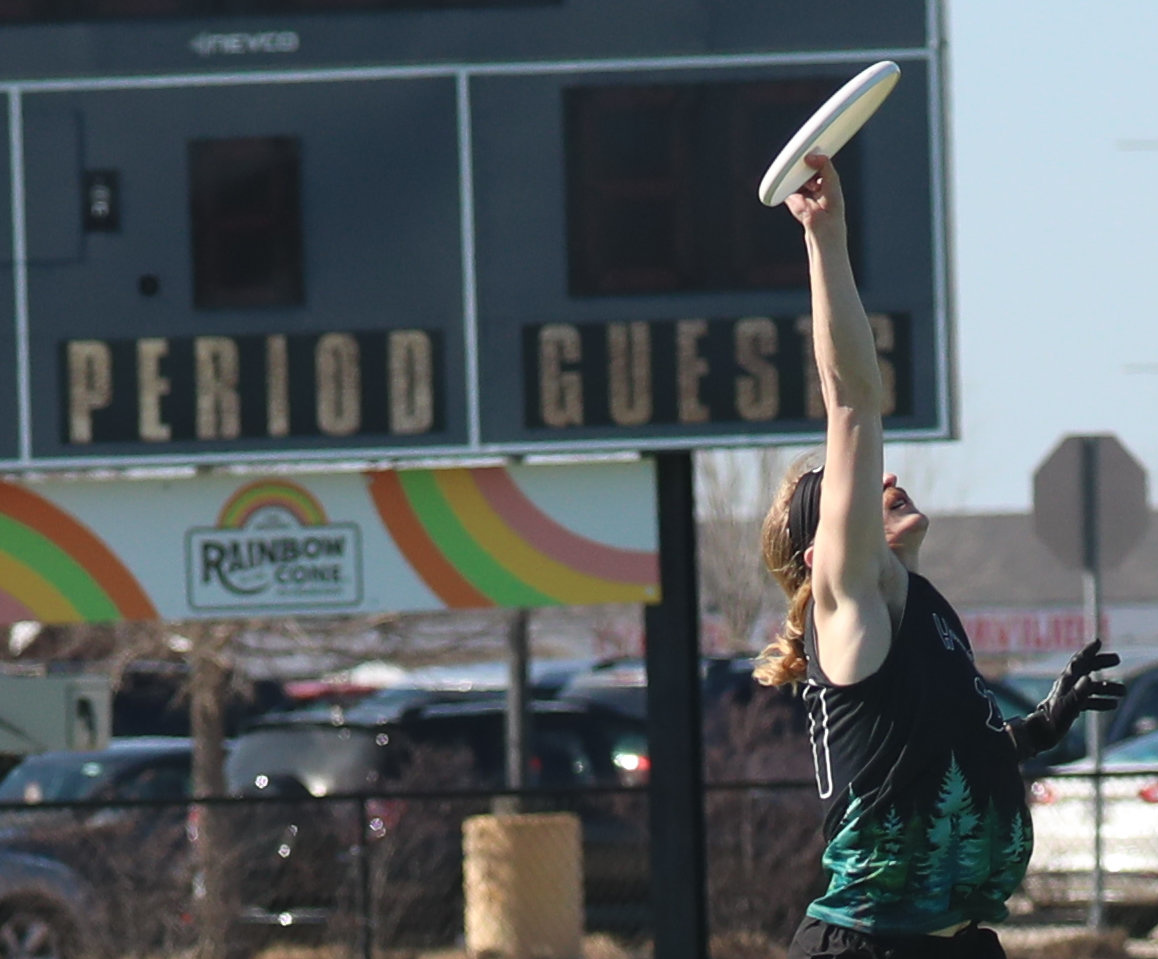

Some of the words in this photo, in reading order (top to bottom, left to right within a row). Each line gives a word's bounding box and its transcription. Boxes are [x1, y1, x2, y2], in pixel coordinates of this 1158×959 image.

[68, 330, 434, 444] PERIOD
[203, 536, 345, 595] RAINBOW
[274, 565, 340, 584] CONE
